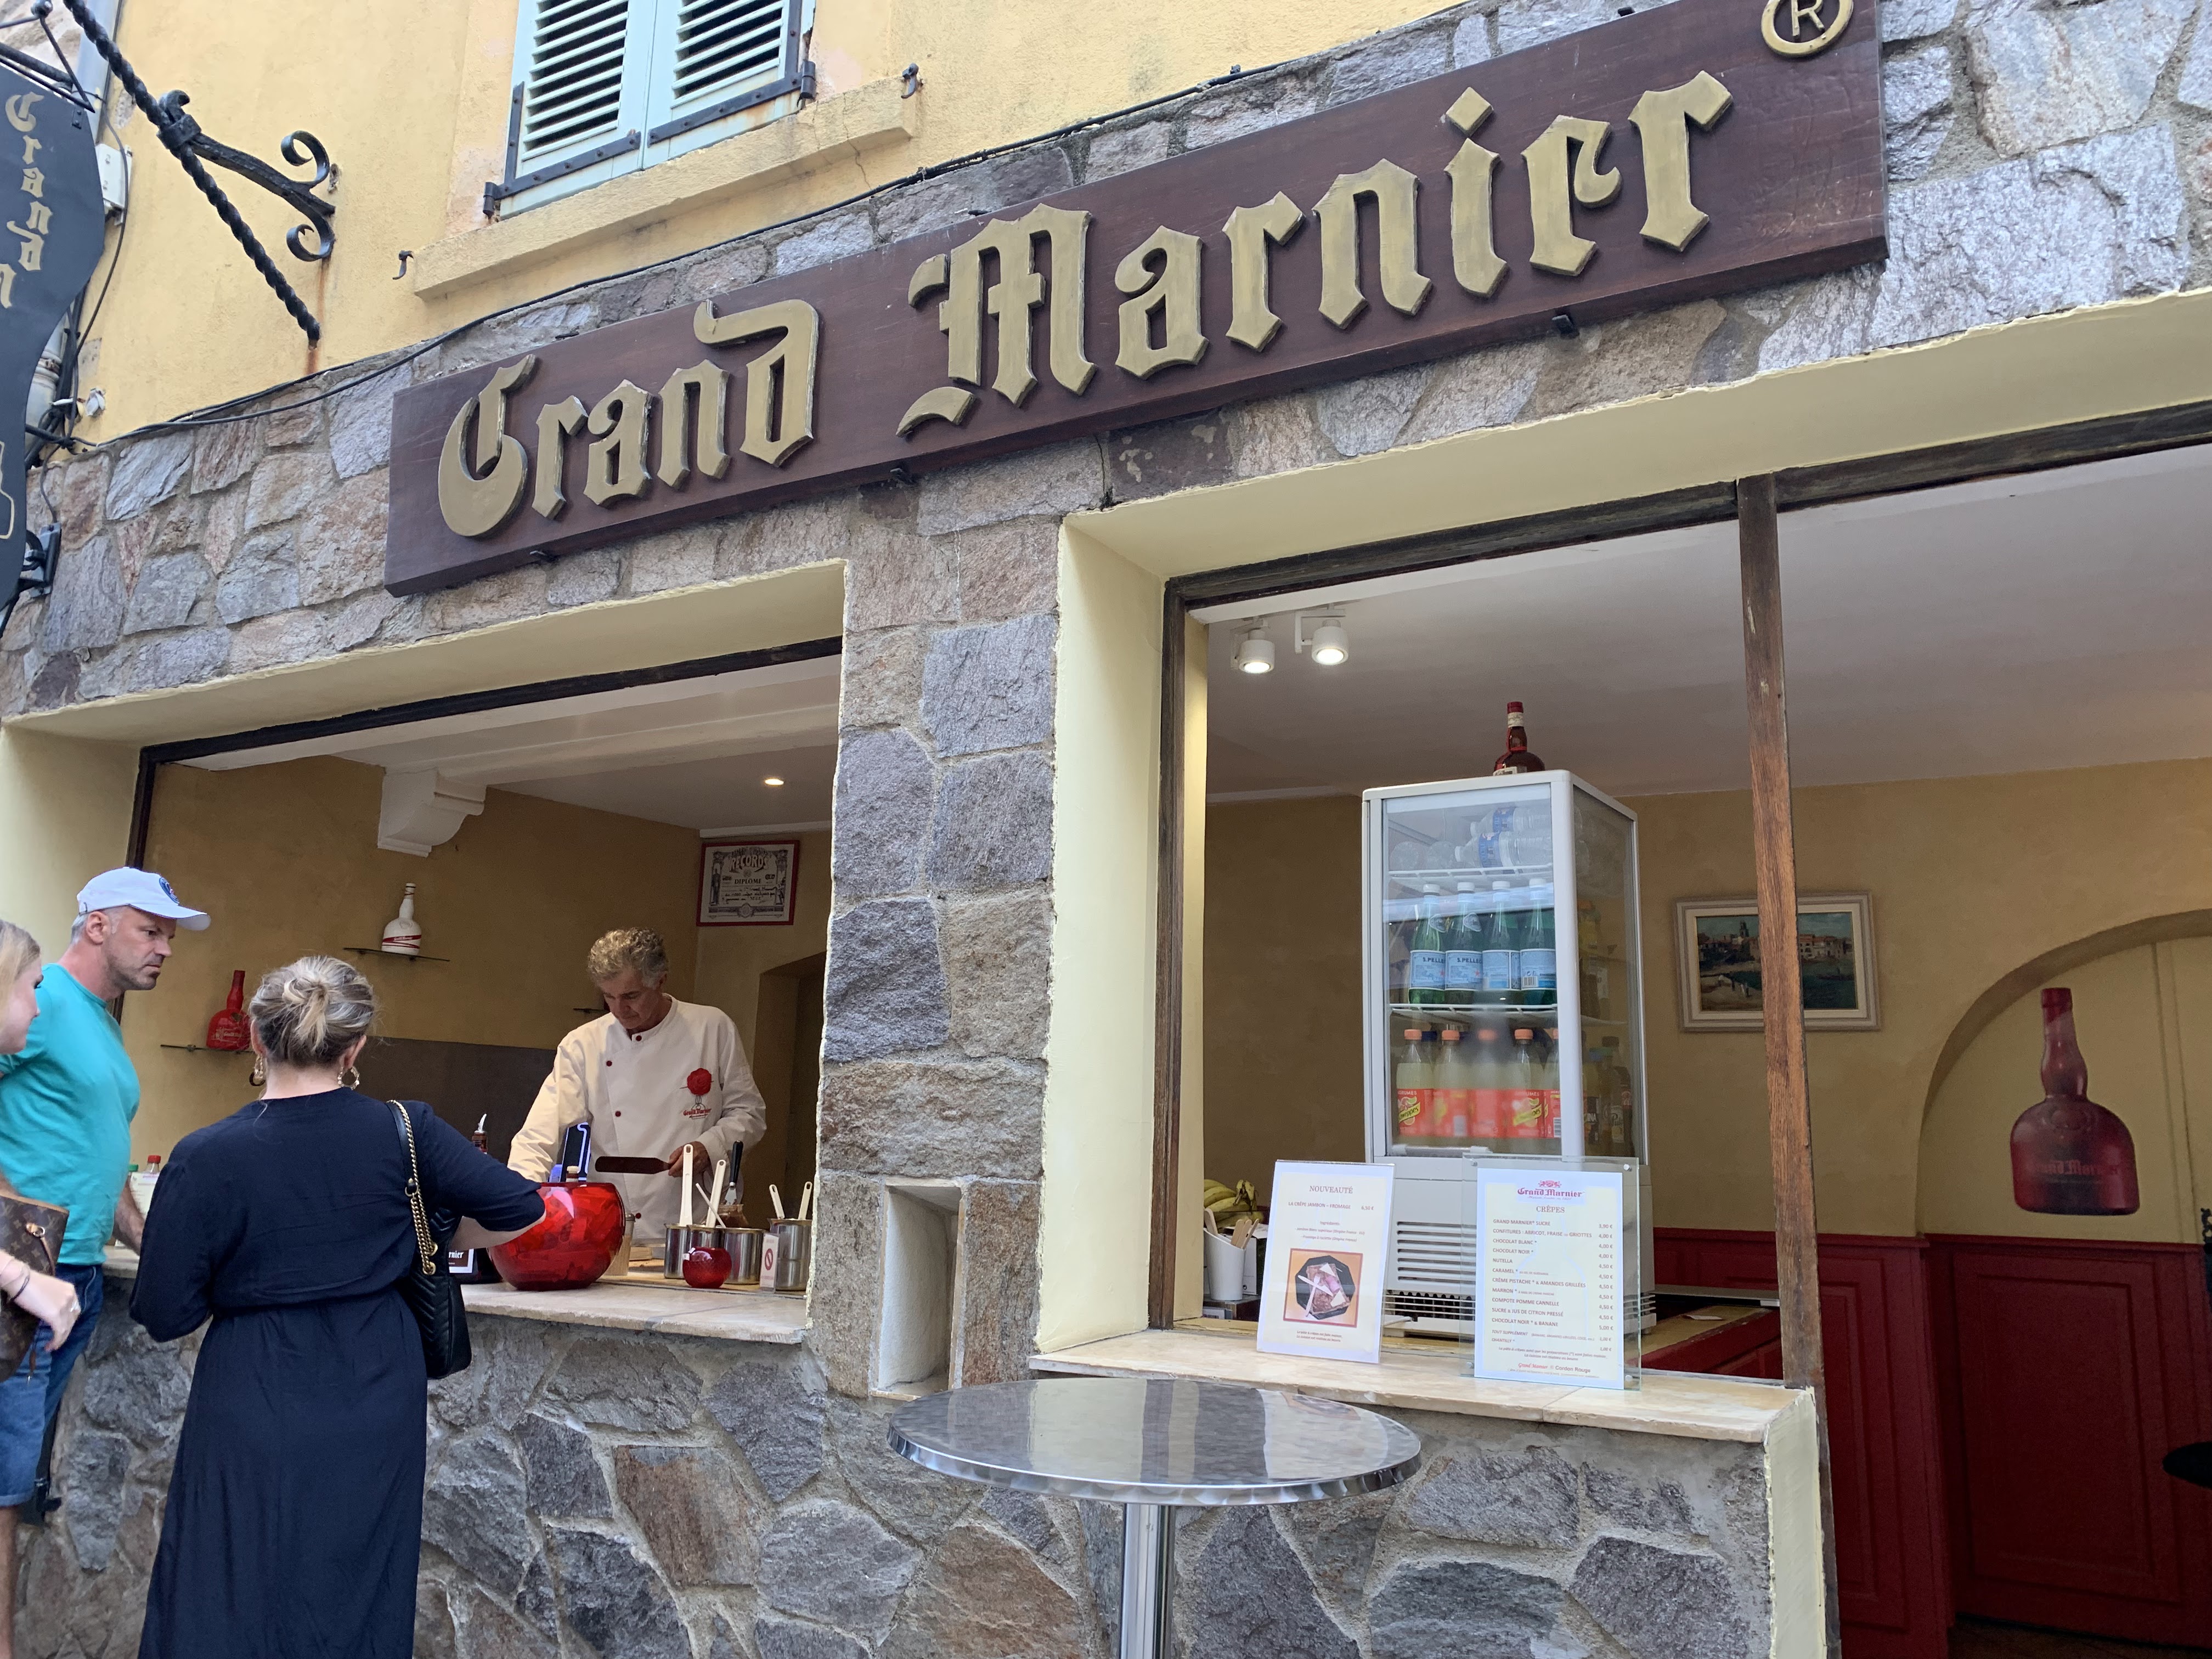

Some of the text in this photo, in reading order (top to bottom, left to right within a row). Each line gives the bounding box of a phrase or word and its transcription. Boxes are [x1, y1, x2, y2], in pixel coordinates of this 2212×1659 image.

[5, 91, 53, 271] Grand
[438, 298, 821, 538] Grand
[896, 70, 1734, 438] Marnier
[1309, 1186, 1353, 1194] NOUVEAUTÉ
[1517, 1187, 1583, 1197] Grand Marnier
[1536, 1205, 1565, 1213] CRÊPES
